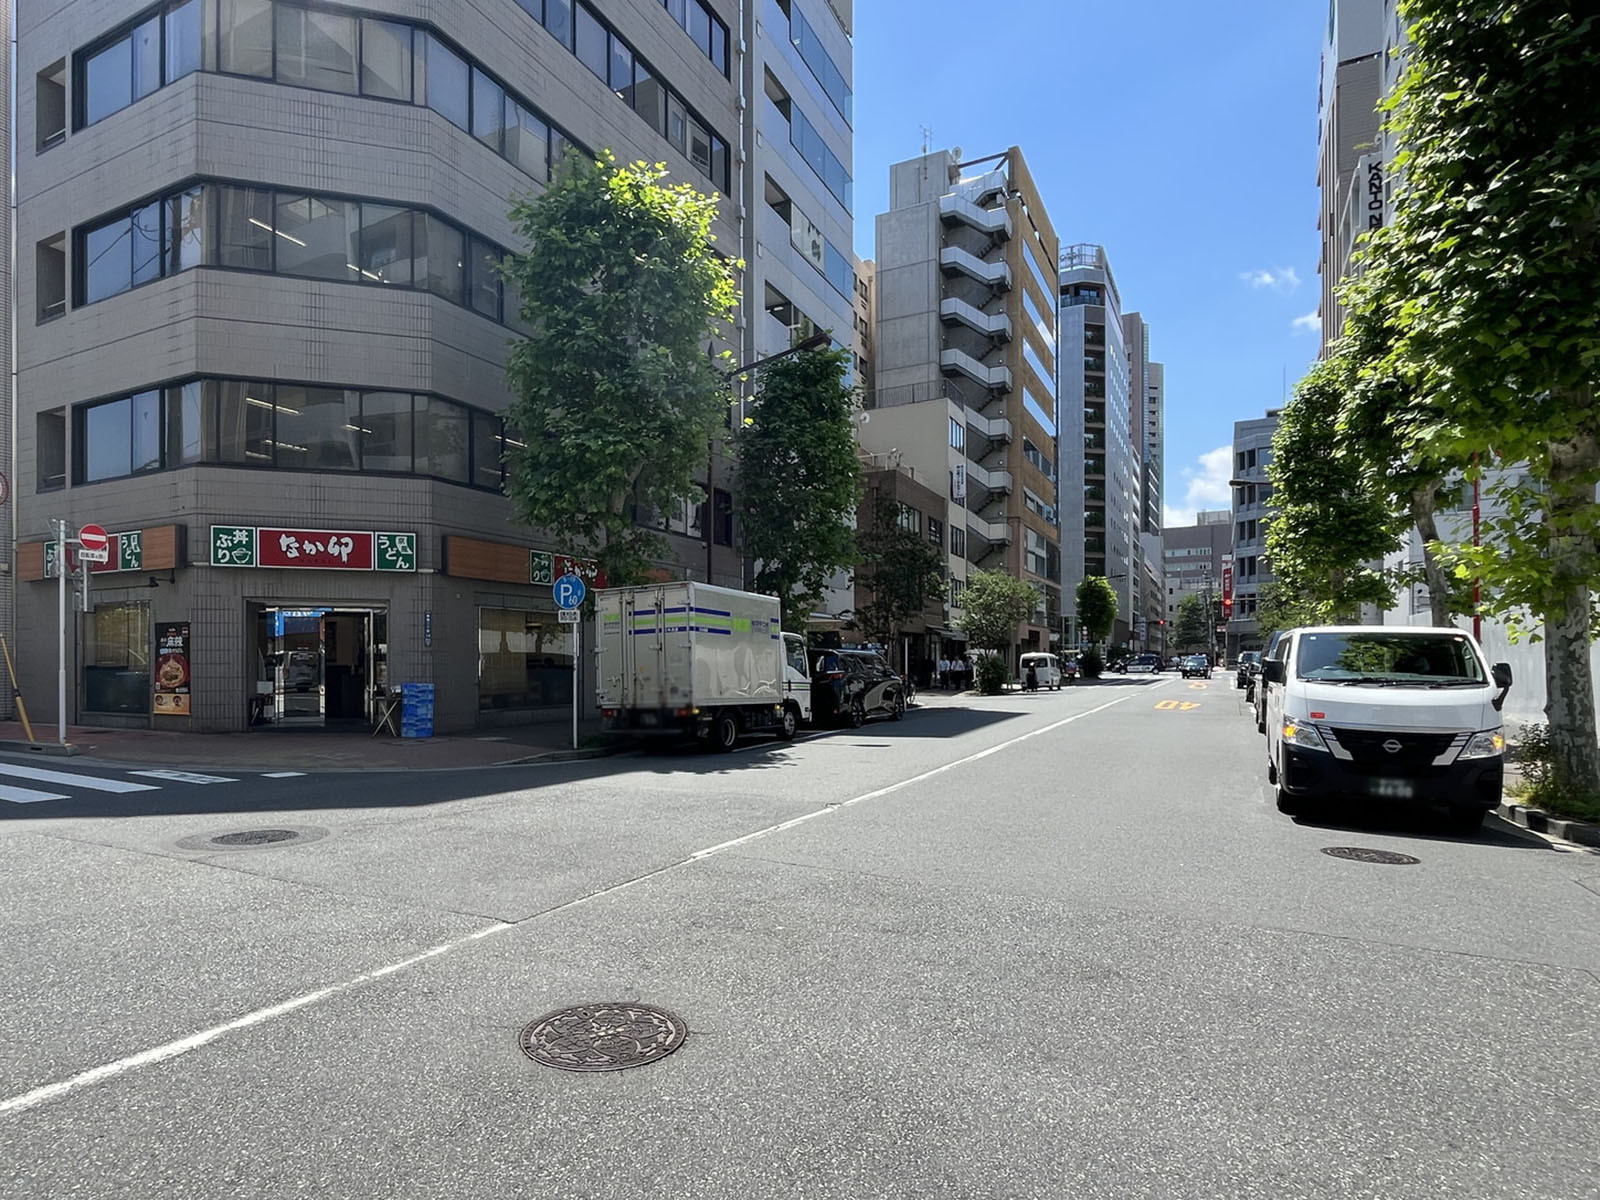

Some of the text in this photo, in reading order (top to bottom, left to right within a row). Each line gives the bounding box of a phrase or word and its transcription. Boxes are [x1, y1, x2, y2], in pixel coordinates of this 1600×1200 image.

[1368, 161, 1383, 210] KANTO
[121, 536, 139, 568] うどん
[279, 533, 353, 564] なか卯
[378, 536, 410, 569] うどん
[560, 584, 573, 605] P
